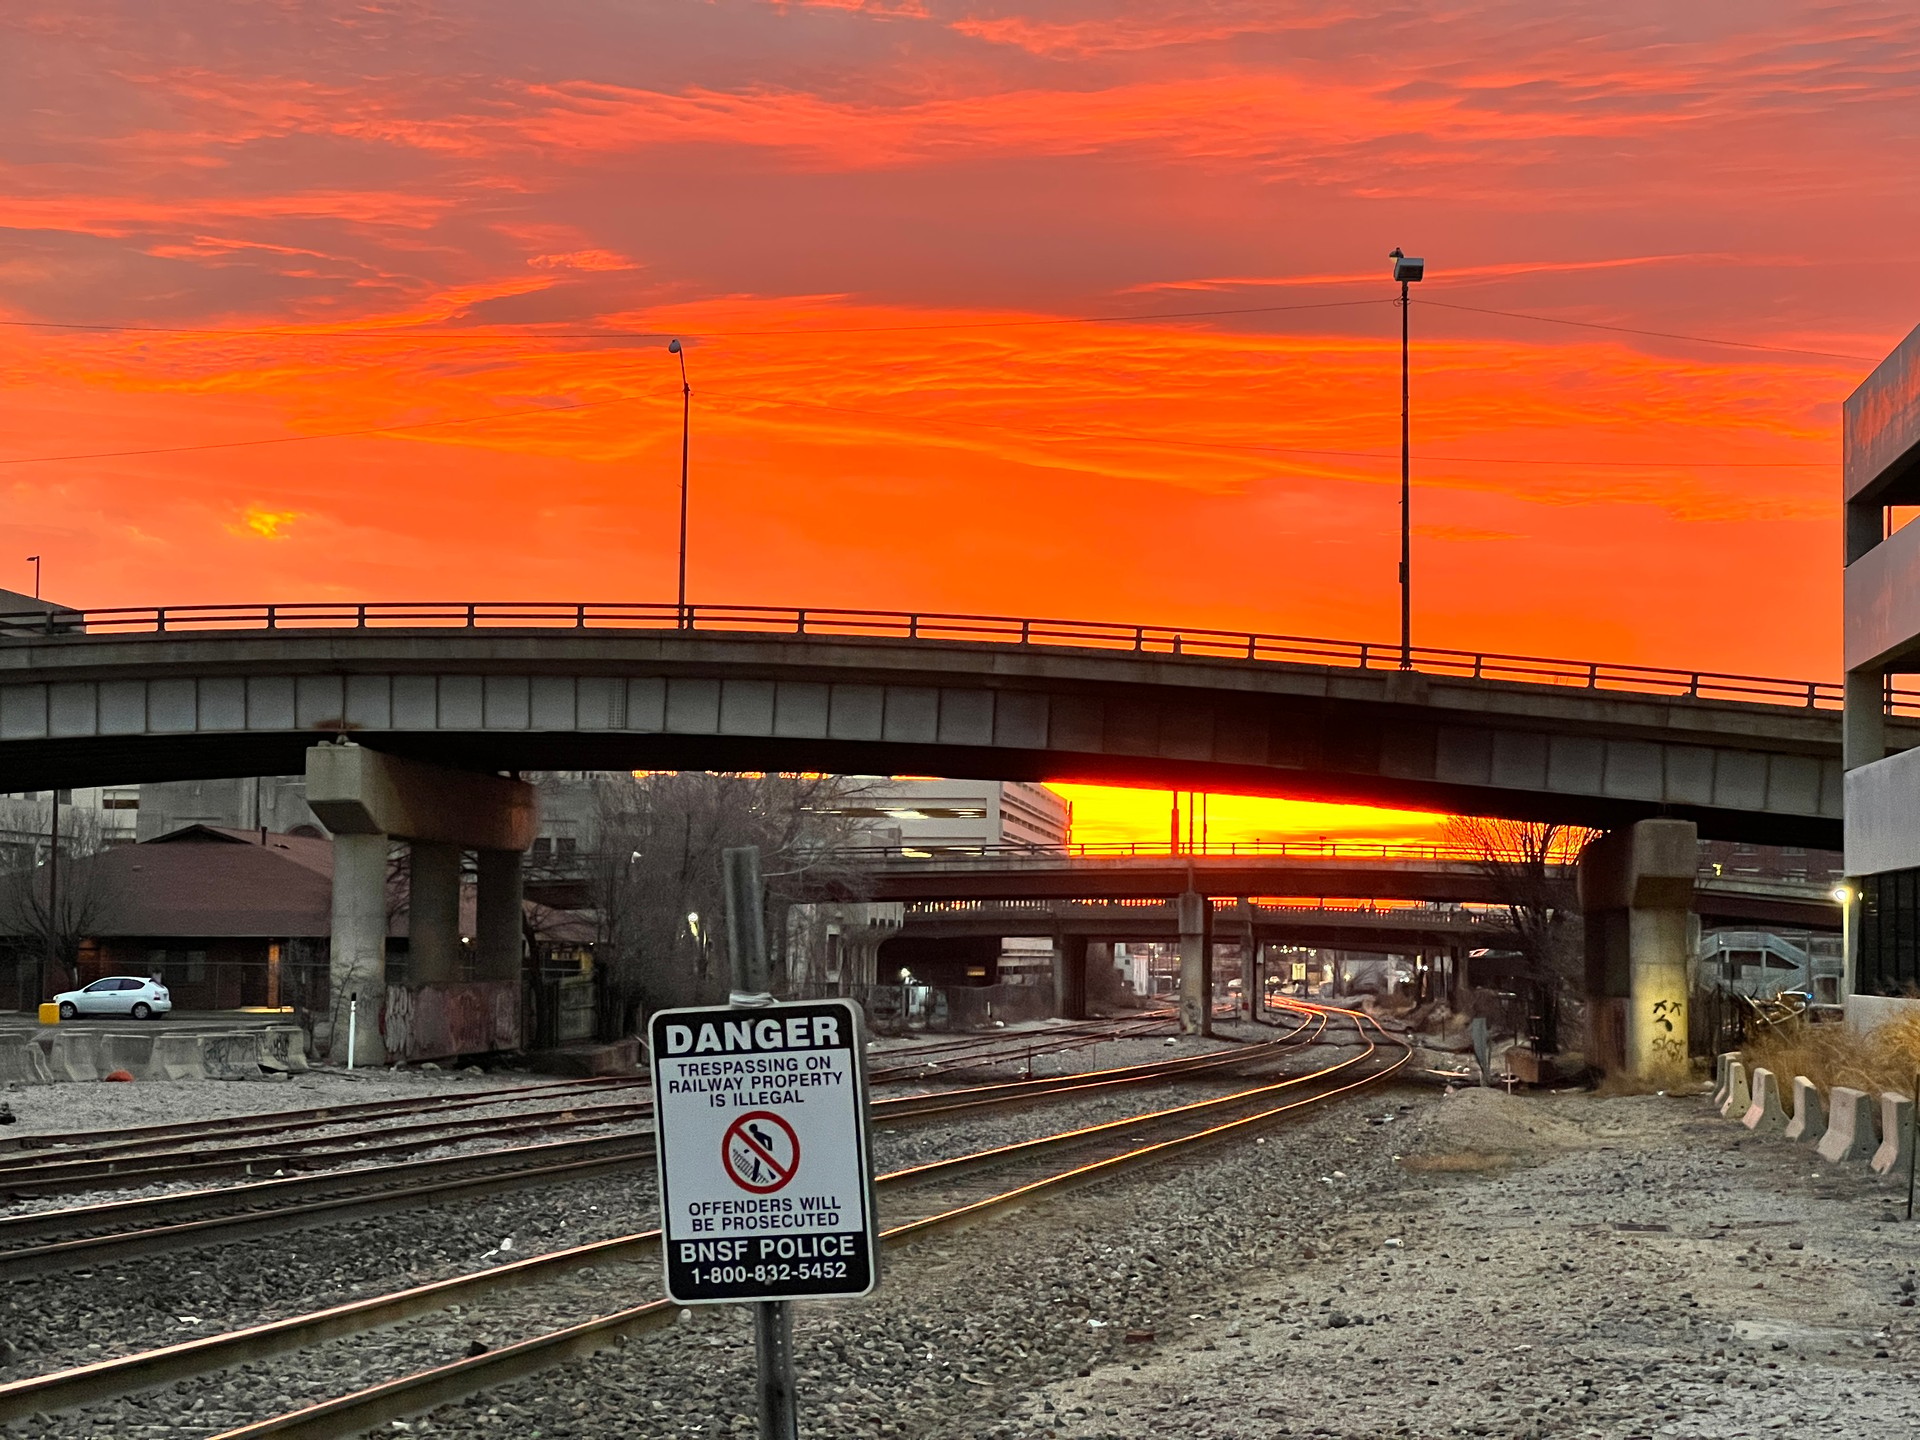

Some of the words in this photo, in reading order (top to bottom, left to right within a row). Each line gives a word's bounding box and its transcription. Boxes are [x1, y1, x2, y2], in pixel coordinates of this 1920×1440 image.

[666, 1017, 840, 1054] DANGER
[678, 1058, 798, 1076] TRESPASSING
[806, 1056, 831, 1069] ON
[670, 1077, 744, 1093] RAILWAY
[751, 1072, 843, 1089] PROPERTY
[710, 1094, 725, 1107] IS
[733, 1090, 804, 1106] ILLEGAL
[689, 1198, 792, 1216] OFFENDERS
[800, 1196, 841, 1210] WILL
[693, 1219, 714, 1232] BE
[722, 1213, 839, 1230] PROSECUTED
[680, 1240, 748, 1263] BNSF
[760, 1236, 855, 1259] POLICE
[691, 1262, 847, 1284] 1-800-832-5452
